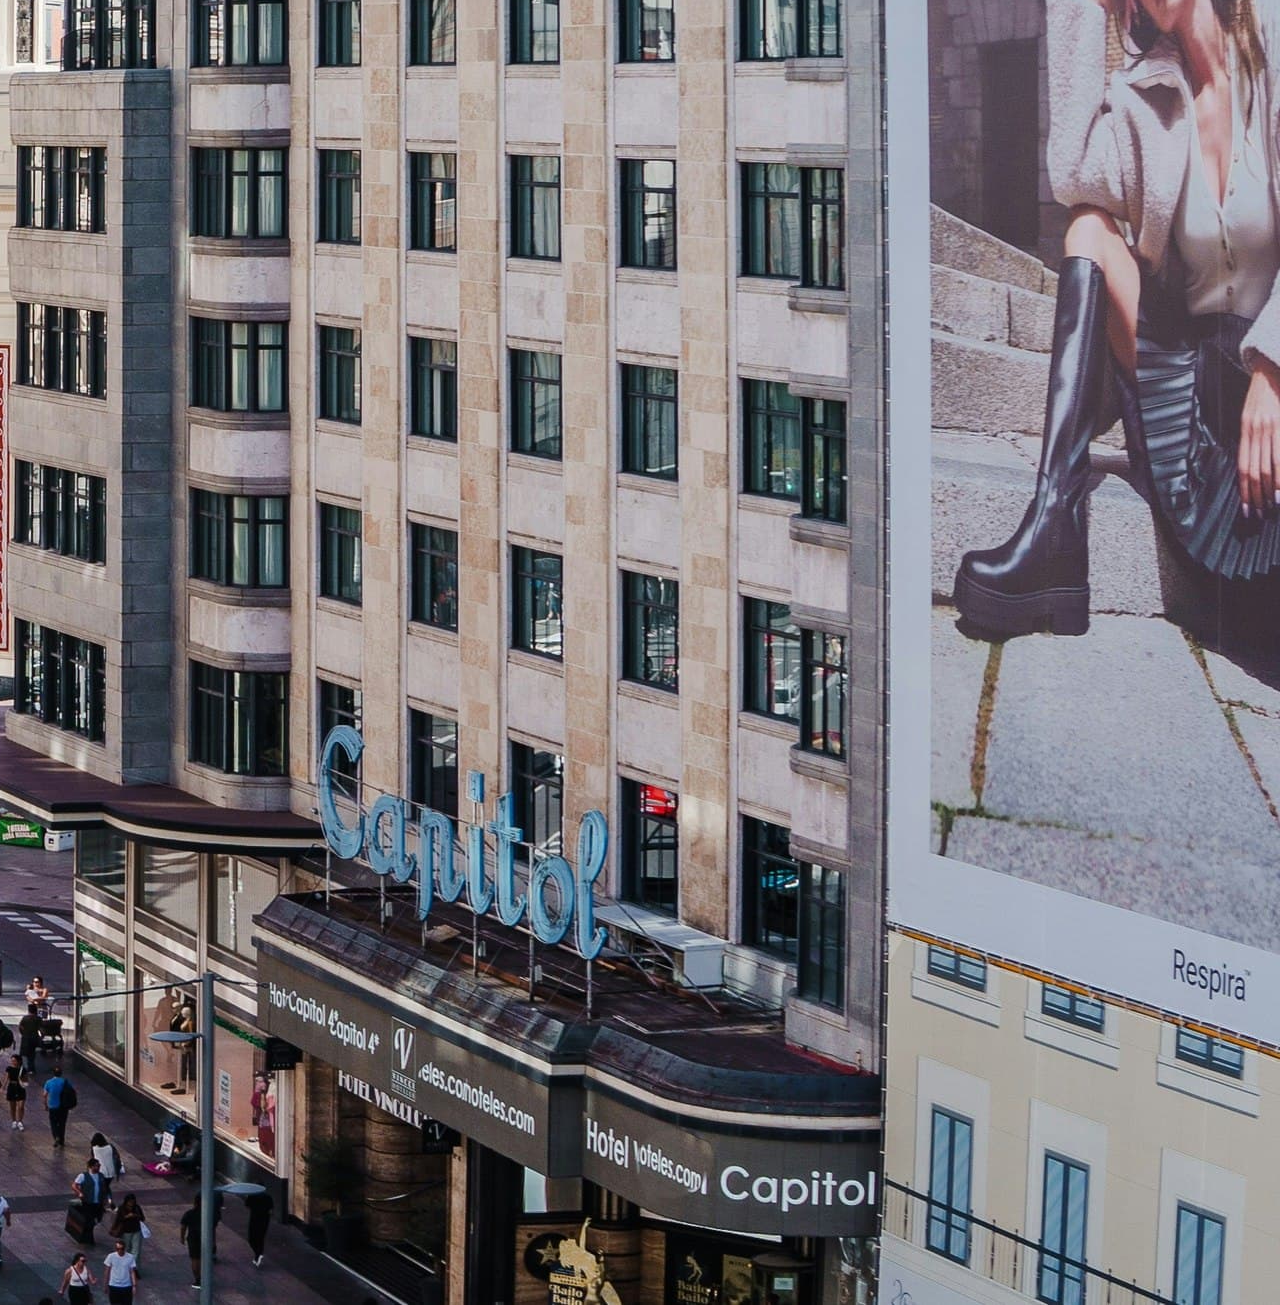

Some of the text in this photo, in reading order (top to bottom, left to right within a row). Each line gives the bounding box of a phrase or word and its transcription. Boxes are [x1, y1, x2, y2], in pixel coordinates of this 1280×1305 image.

[1173, 948, 1245, 1001] Respira
[288, 990, 326, 1027] Capitol
[587, 1118, 629, 1168] Hotel
[720, 1165, 875, 1212] Capitol
